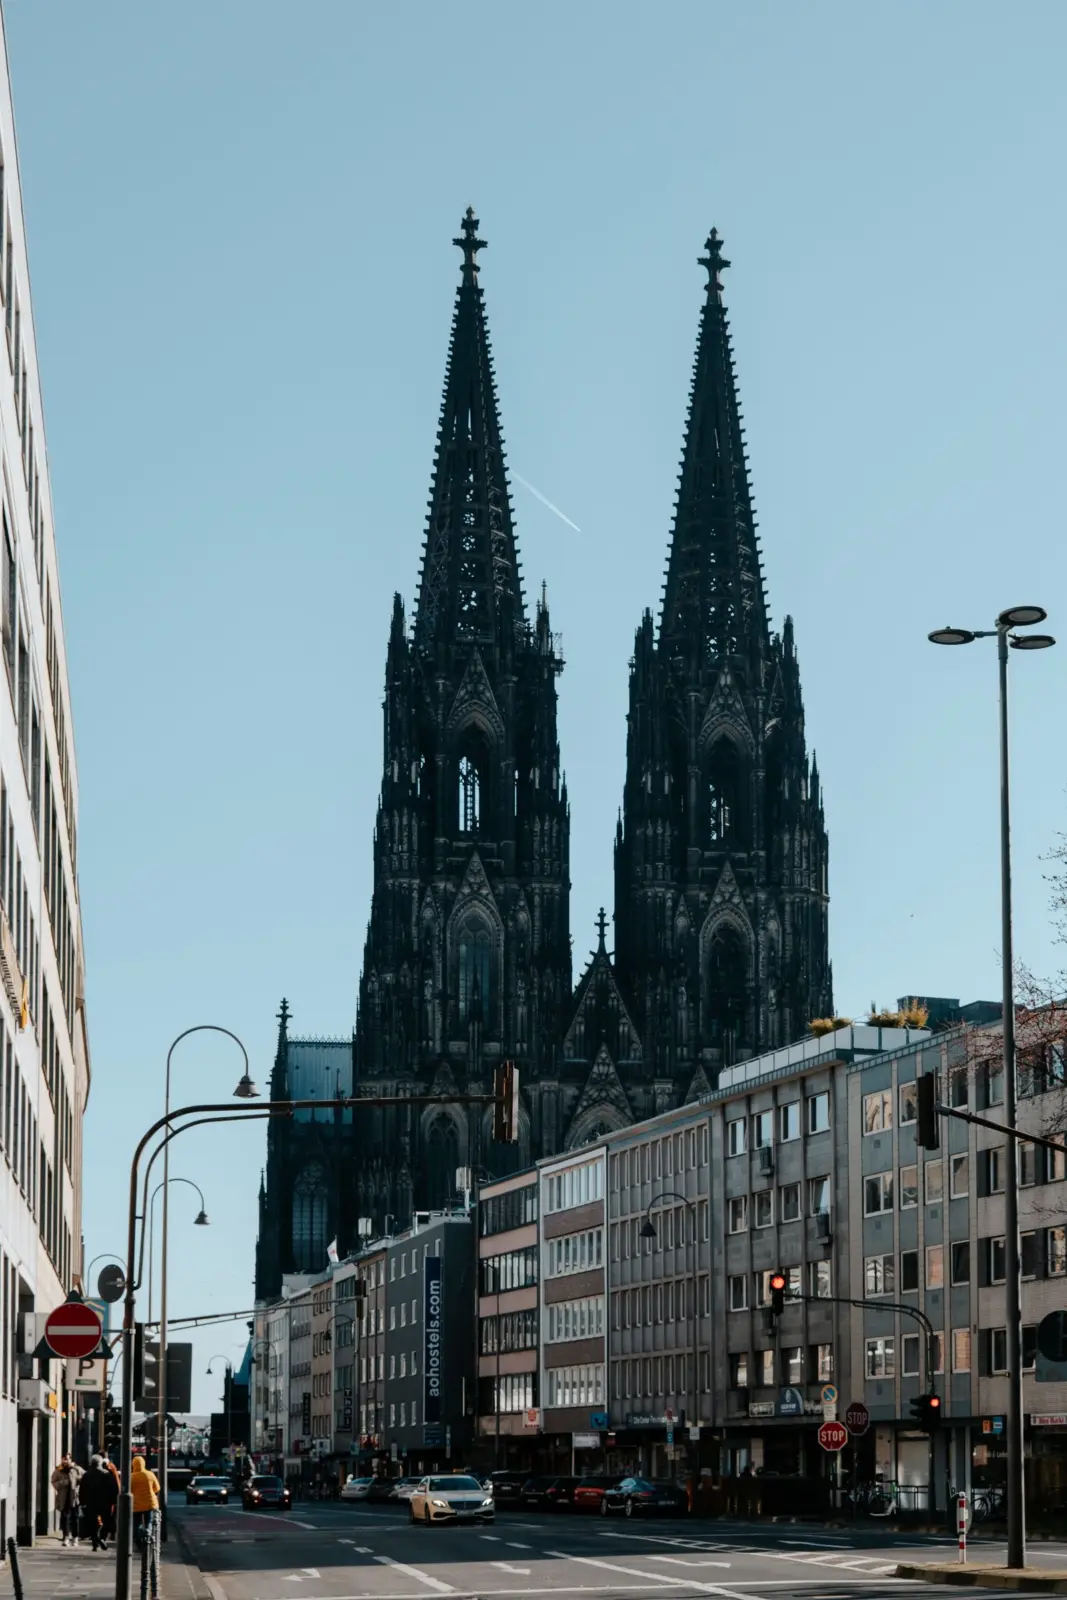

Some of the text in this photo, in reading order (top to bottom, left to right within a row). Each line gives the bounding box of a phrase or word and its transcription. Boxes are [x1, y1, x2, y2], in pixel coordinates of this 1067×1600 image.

[426, 1279, 440, 1397] aohostels.com
[78, 1358, 94, 1377] P
[847, 1411, 868, 1425] STOP
[820, 1430, 845, 1442] STOP
